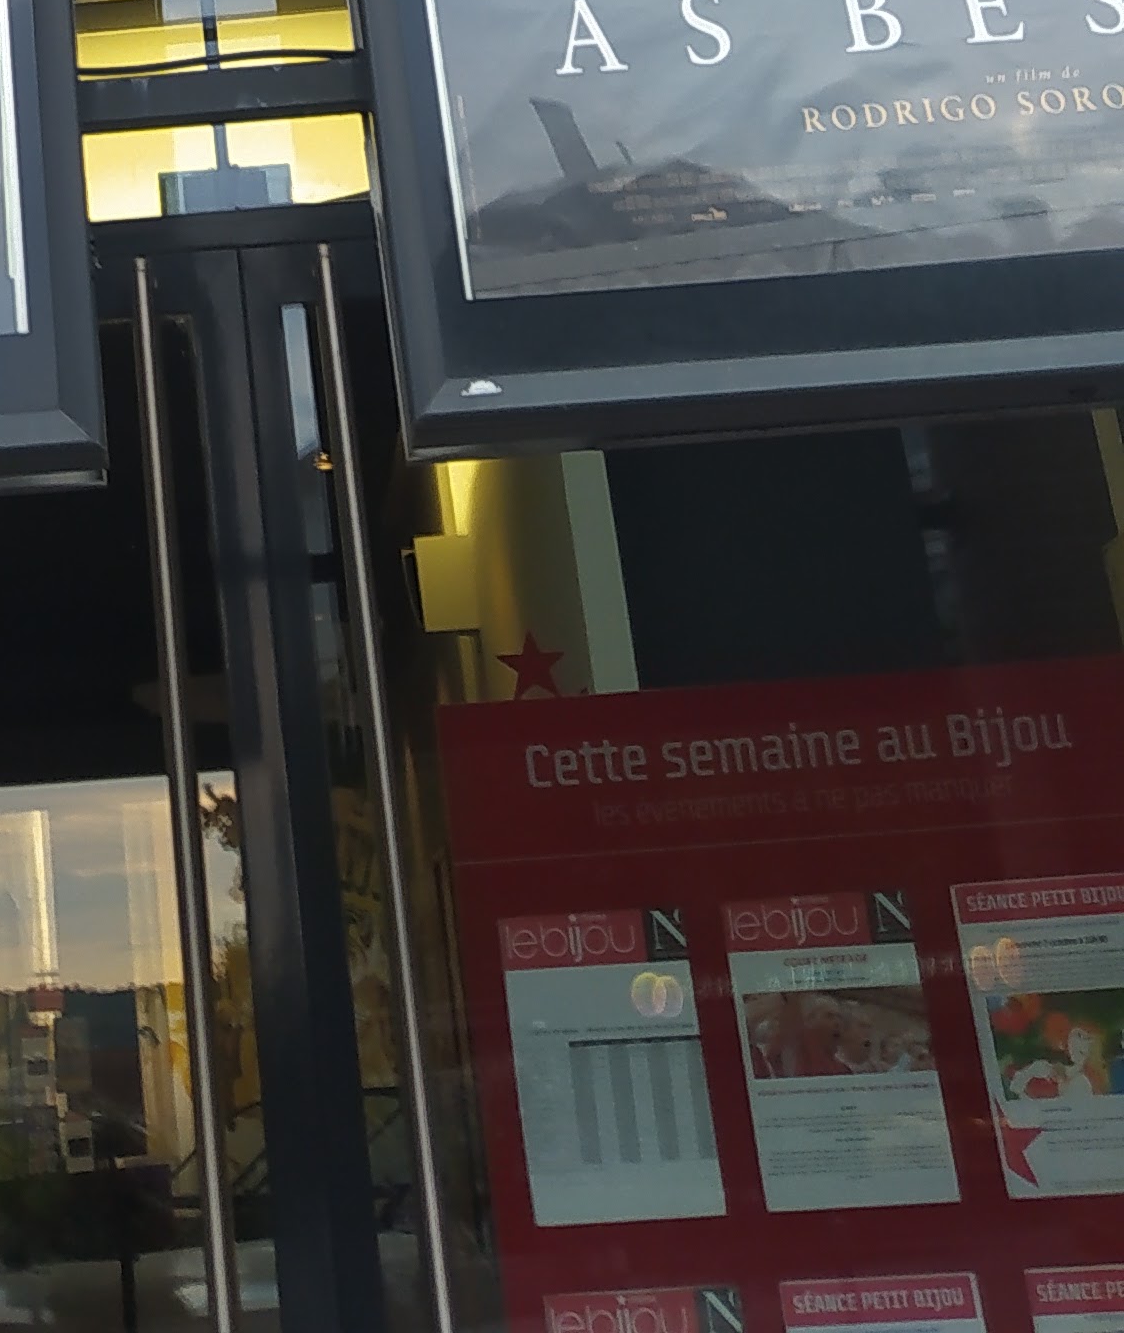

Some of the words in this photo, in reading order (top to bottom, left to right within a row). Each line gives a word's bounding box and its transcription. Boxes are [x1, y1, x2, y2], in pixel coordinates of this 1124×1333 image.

[985, 73, 1006, 85] un
[1015, 66, 1052, 83] film
[1061, 65, 1081, 80] de
[803, 92, 997, 134] RODRIGO
[525, 739, 648, 789] Cette
[661, 722, 862, 779] semaine
[877, 724, 937, 764] au
[945, 705, 1073, 768] Bijou
[854, 783, 901, 814] pas
[907, 774, 1013, 808] manquer
[1031, 888, 1076, 908] PETIT
[861, 1288, 912, 1311] PETIT
